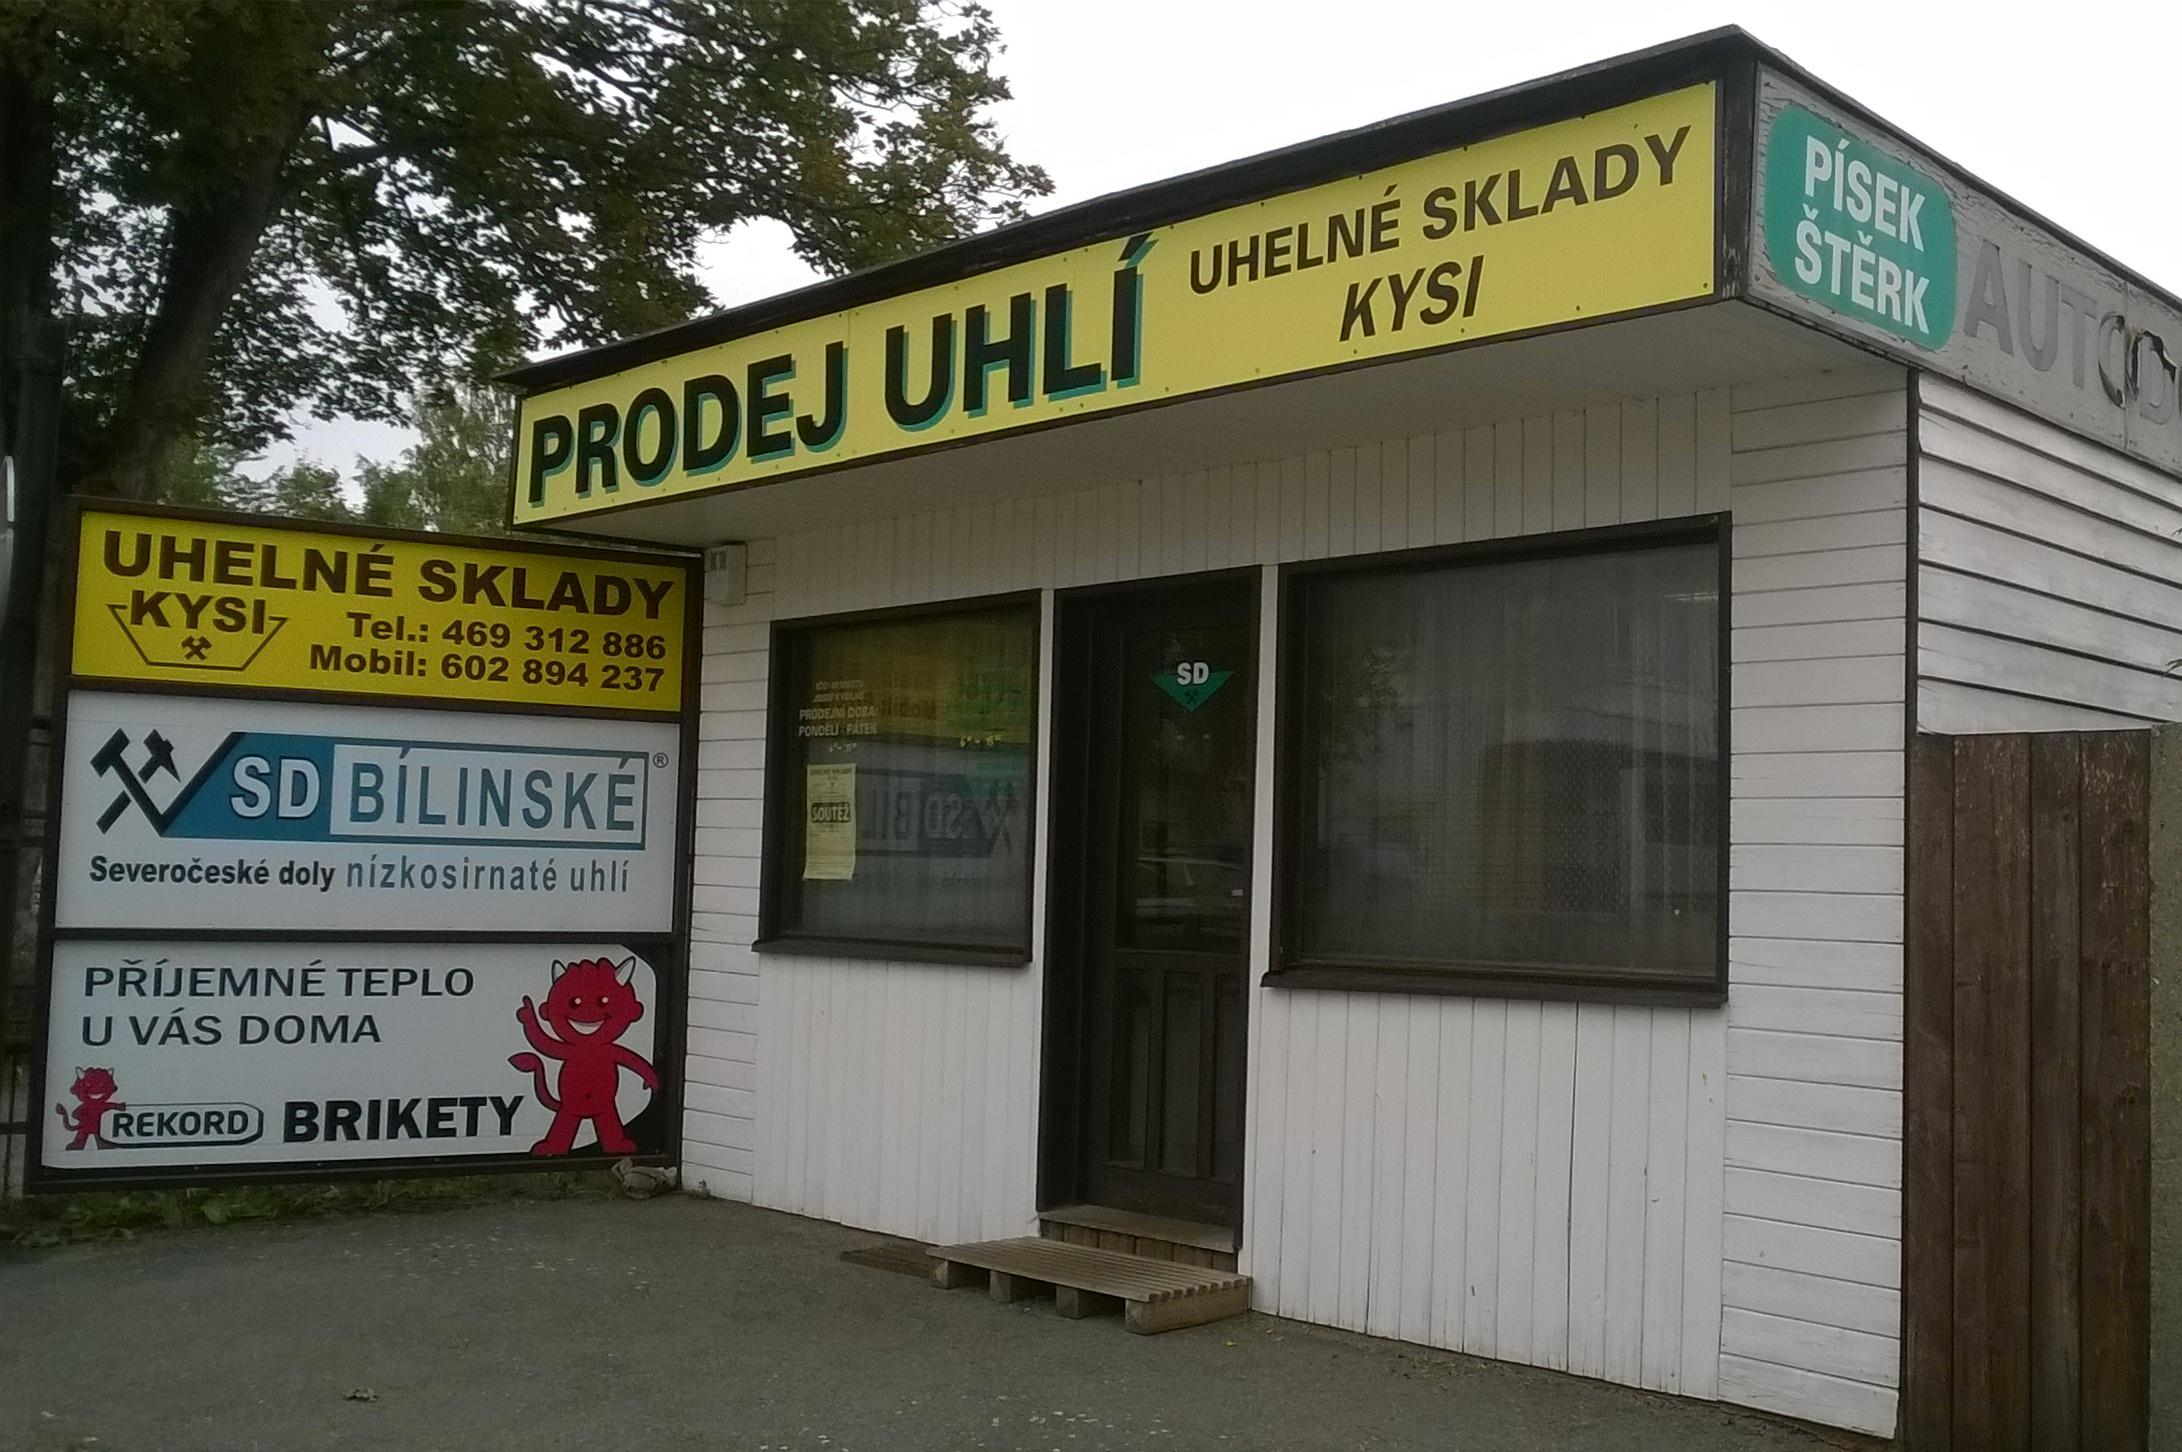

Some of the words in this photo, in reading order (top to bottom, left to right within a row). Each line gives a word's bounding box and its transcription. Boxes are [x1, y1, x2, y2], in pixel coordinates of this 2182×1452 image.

[1190, 184, 1401, 295] UHELNÉ
[1423, 125, 1692, 240] SKLADY
[1804, 135, 1926, 253] PÍSEK
[1795, 203, 1930, 335] ŠTĚRK
[1339, 254, 1485, 342] KYSI
[528, 340, 849, 508] PRODEJ
[885, 233, 1157, 432] UHLÍ
[102, 530, 395, 598] UHELNÉ
[419, 558, 674, 620] SKLADY
[129, 590, 267, 635] KYSI
[347, 612, 430, 643] Tel.:
[442, 620, 511, 649] 469
[525, 625, 590, 654] 312
[602, 630, 667, 659] 886
[310, 644, 427, 677] Mobil:
[441, 654, 508, 682] 602
[522, 659, 588, 687] 894
[602, 664, 664, 692] 237
[1177, 662, 1210, 685] SD
[230, 754, 321, 820] SD
[349, 748, 637, 831] BÍLINSKÉ
[89, 854, 270, 886] Severočeské
[278, 859, 335, 892] doly
[346, 854, 557, 892] nízkosirnaté
[570, 858, 630, 892] uhlí
[84, 959, 325, 998] PŘÍJEMNÉ
[337, 967, 475, 998] TEPLO
[81, 1016, 112, 1047] U
[129, 1007, 222, 1046] VÁS
[238, 1014, 382, 1045] DOMA
[111, 1109, 249, 1138] REKORD
[283, 1095, 524, 1143] BRIKETY
